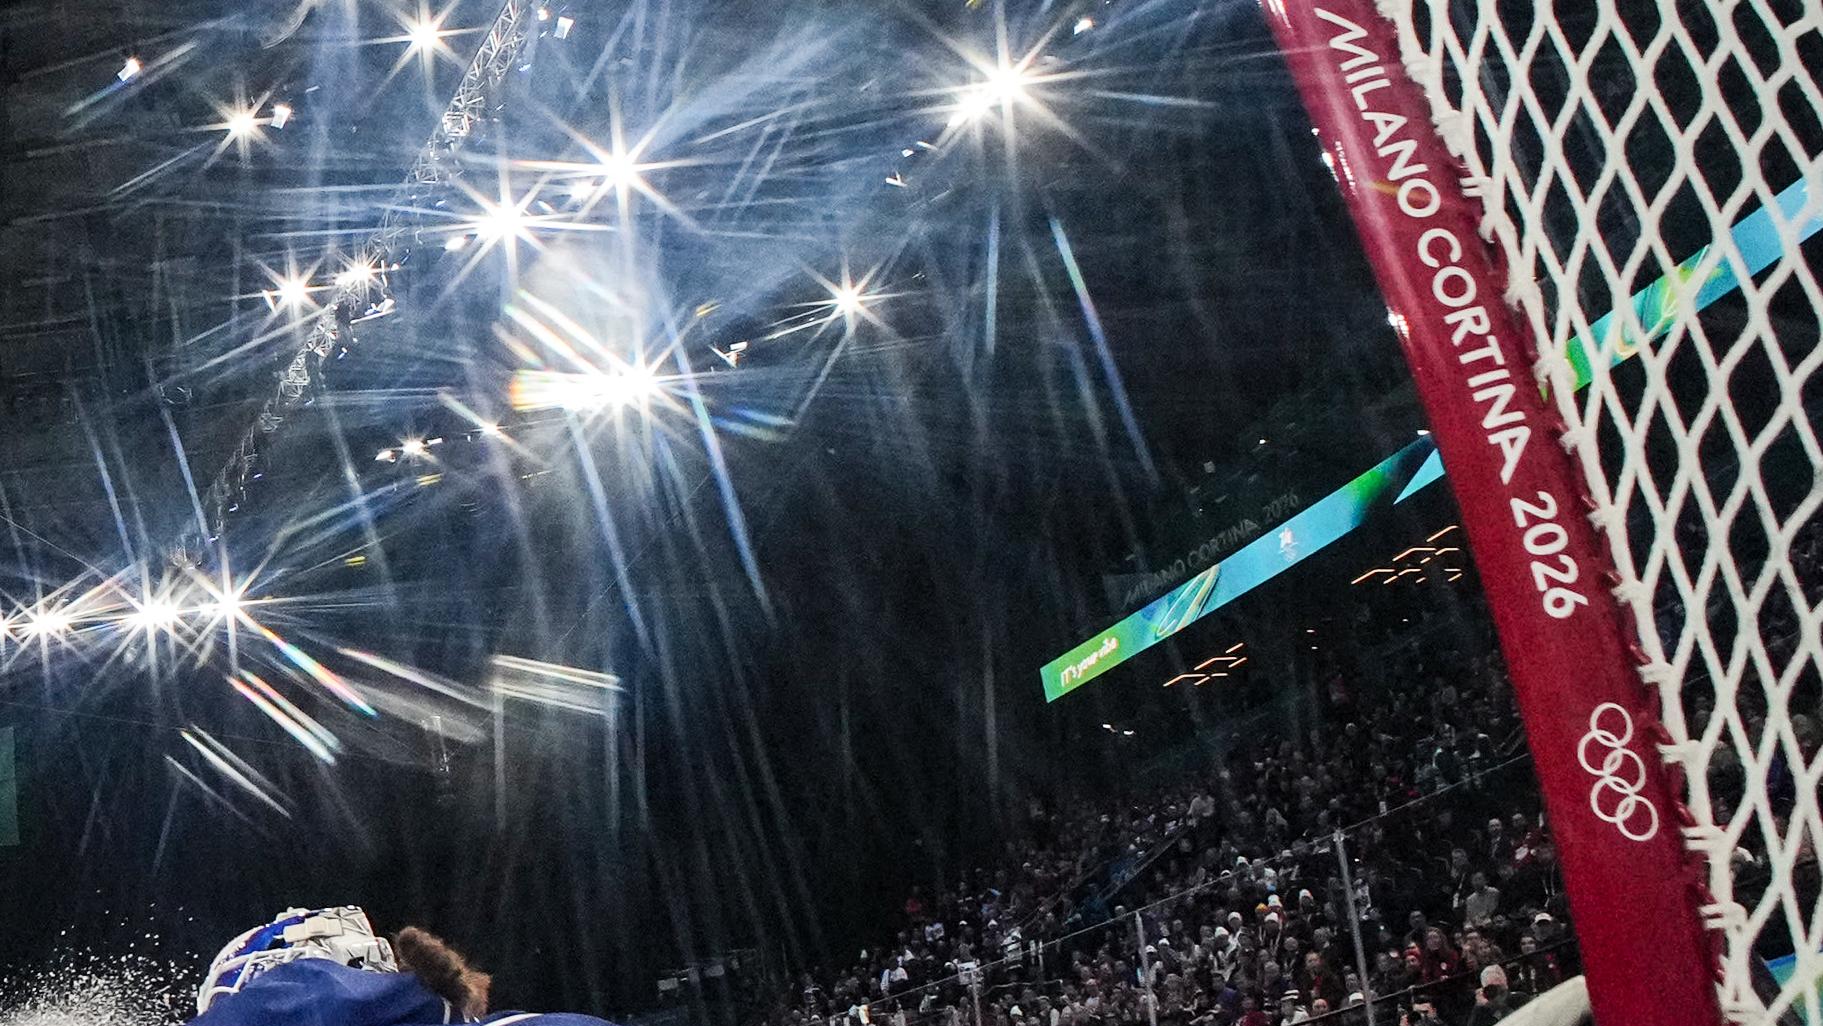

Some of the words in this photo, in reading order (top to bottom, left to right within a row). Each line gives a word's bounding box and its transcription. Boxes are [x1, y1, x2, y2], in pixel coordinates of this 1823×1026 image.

[1315, 8, 1441, 219] MILANO
[1417, 228, 1532, 485] CORTINA
[1510, 491, 1588, 620] 2026
